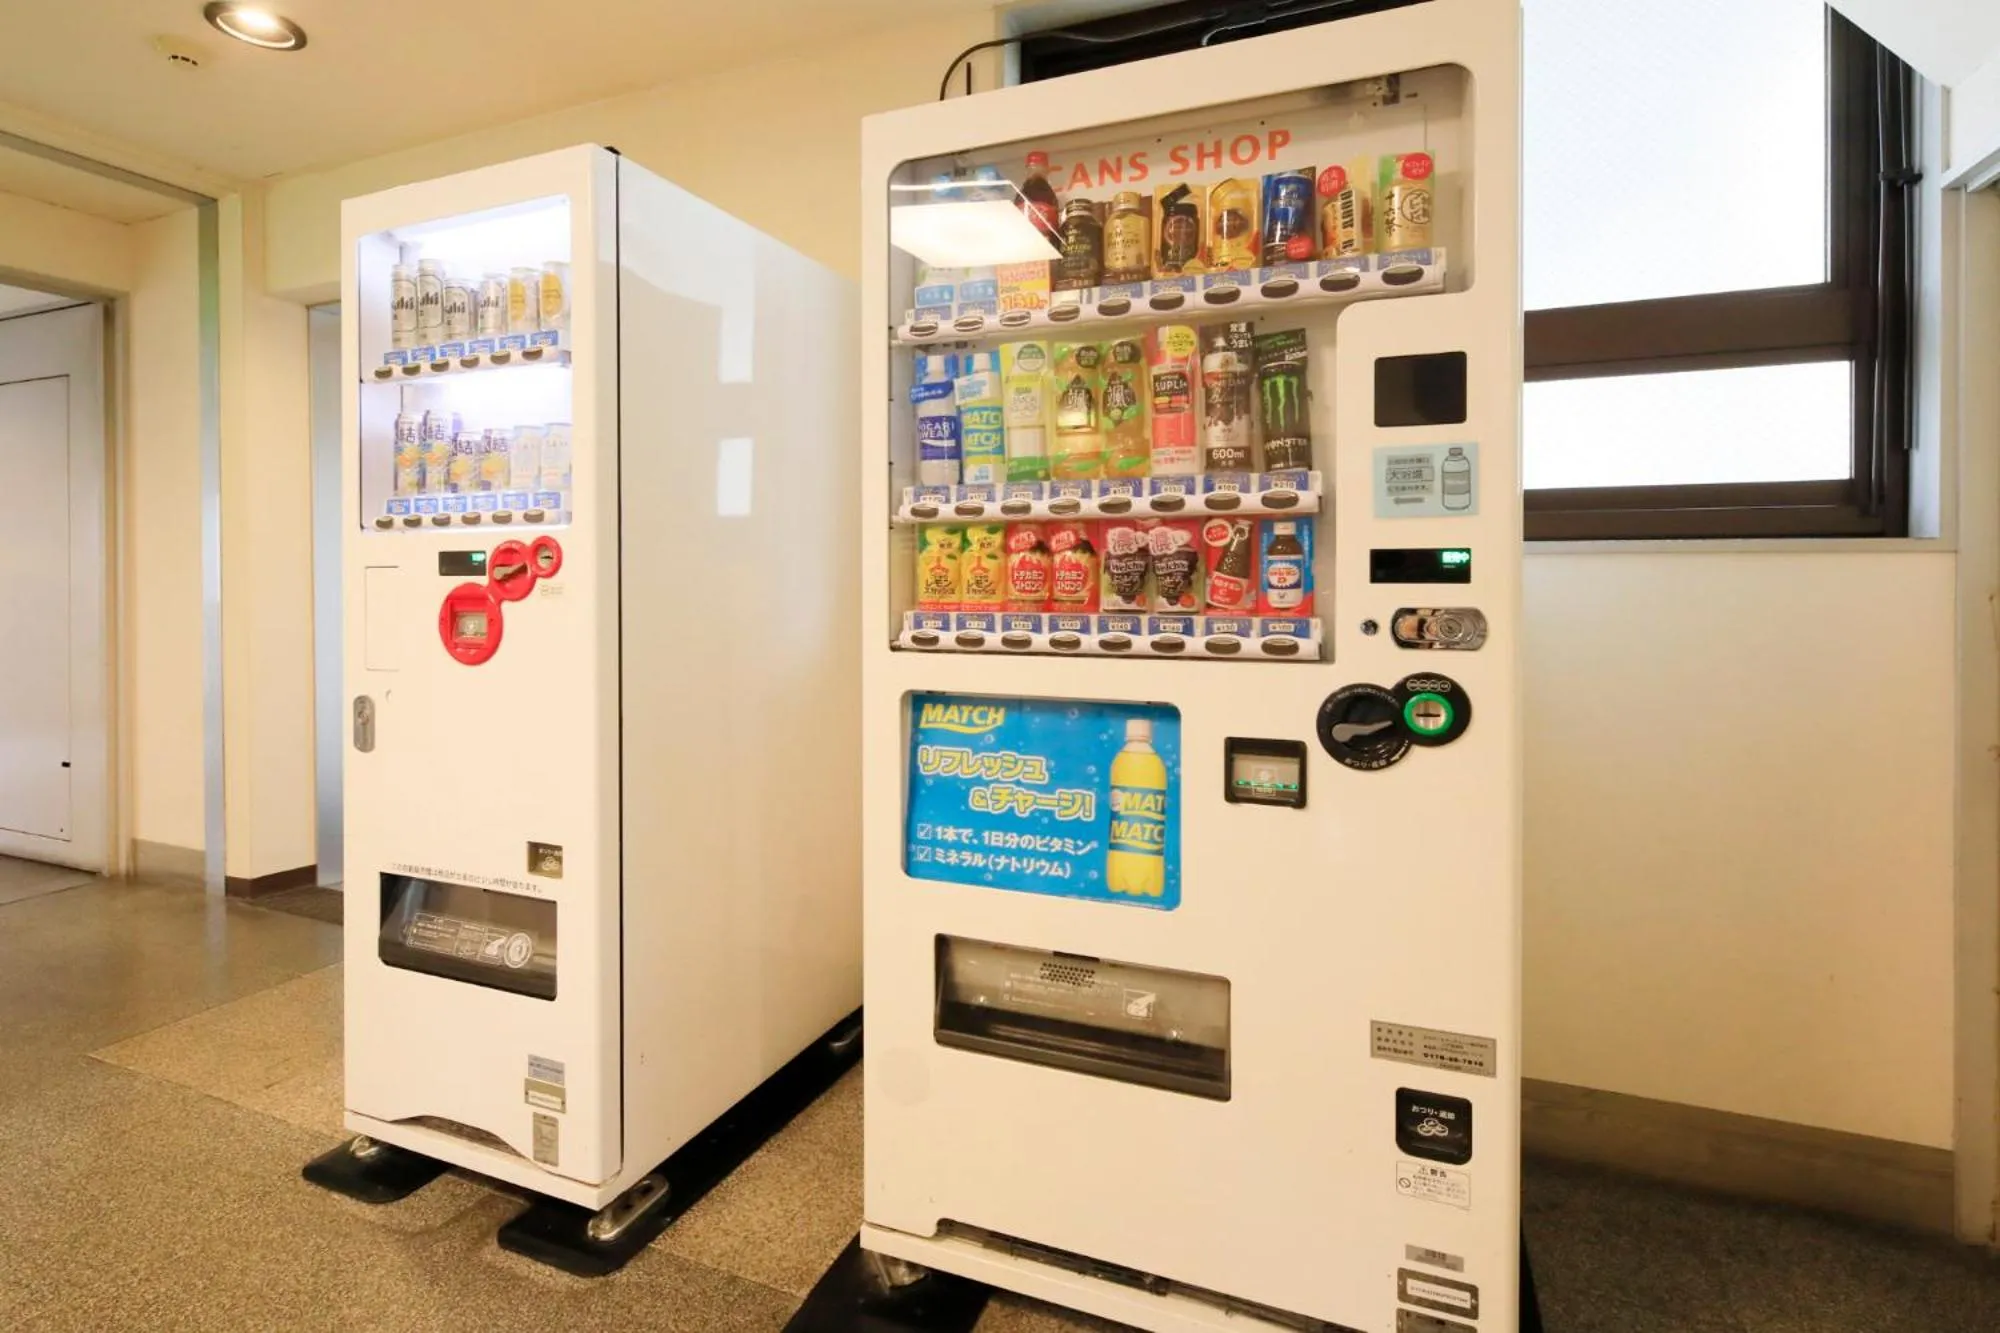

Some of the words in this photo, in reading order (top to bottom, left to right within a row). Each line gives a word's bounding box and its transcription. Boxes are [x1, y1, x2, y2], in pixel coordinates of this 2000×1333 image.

[1168, 129, 1292, 176] SHOP
[1212, 448, 1244, 459] 600ml
[920, 704, 1006, 731] MATCH
[918, 746, 1048, 783] リフレッシュ
[935, 847, 1071, 879] ミネラル(ナトリウム)
